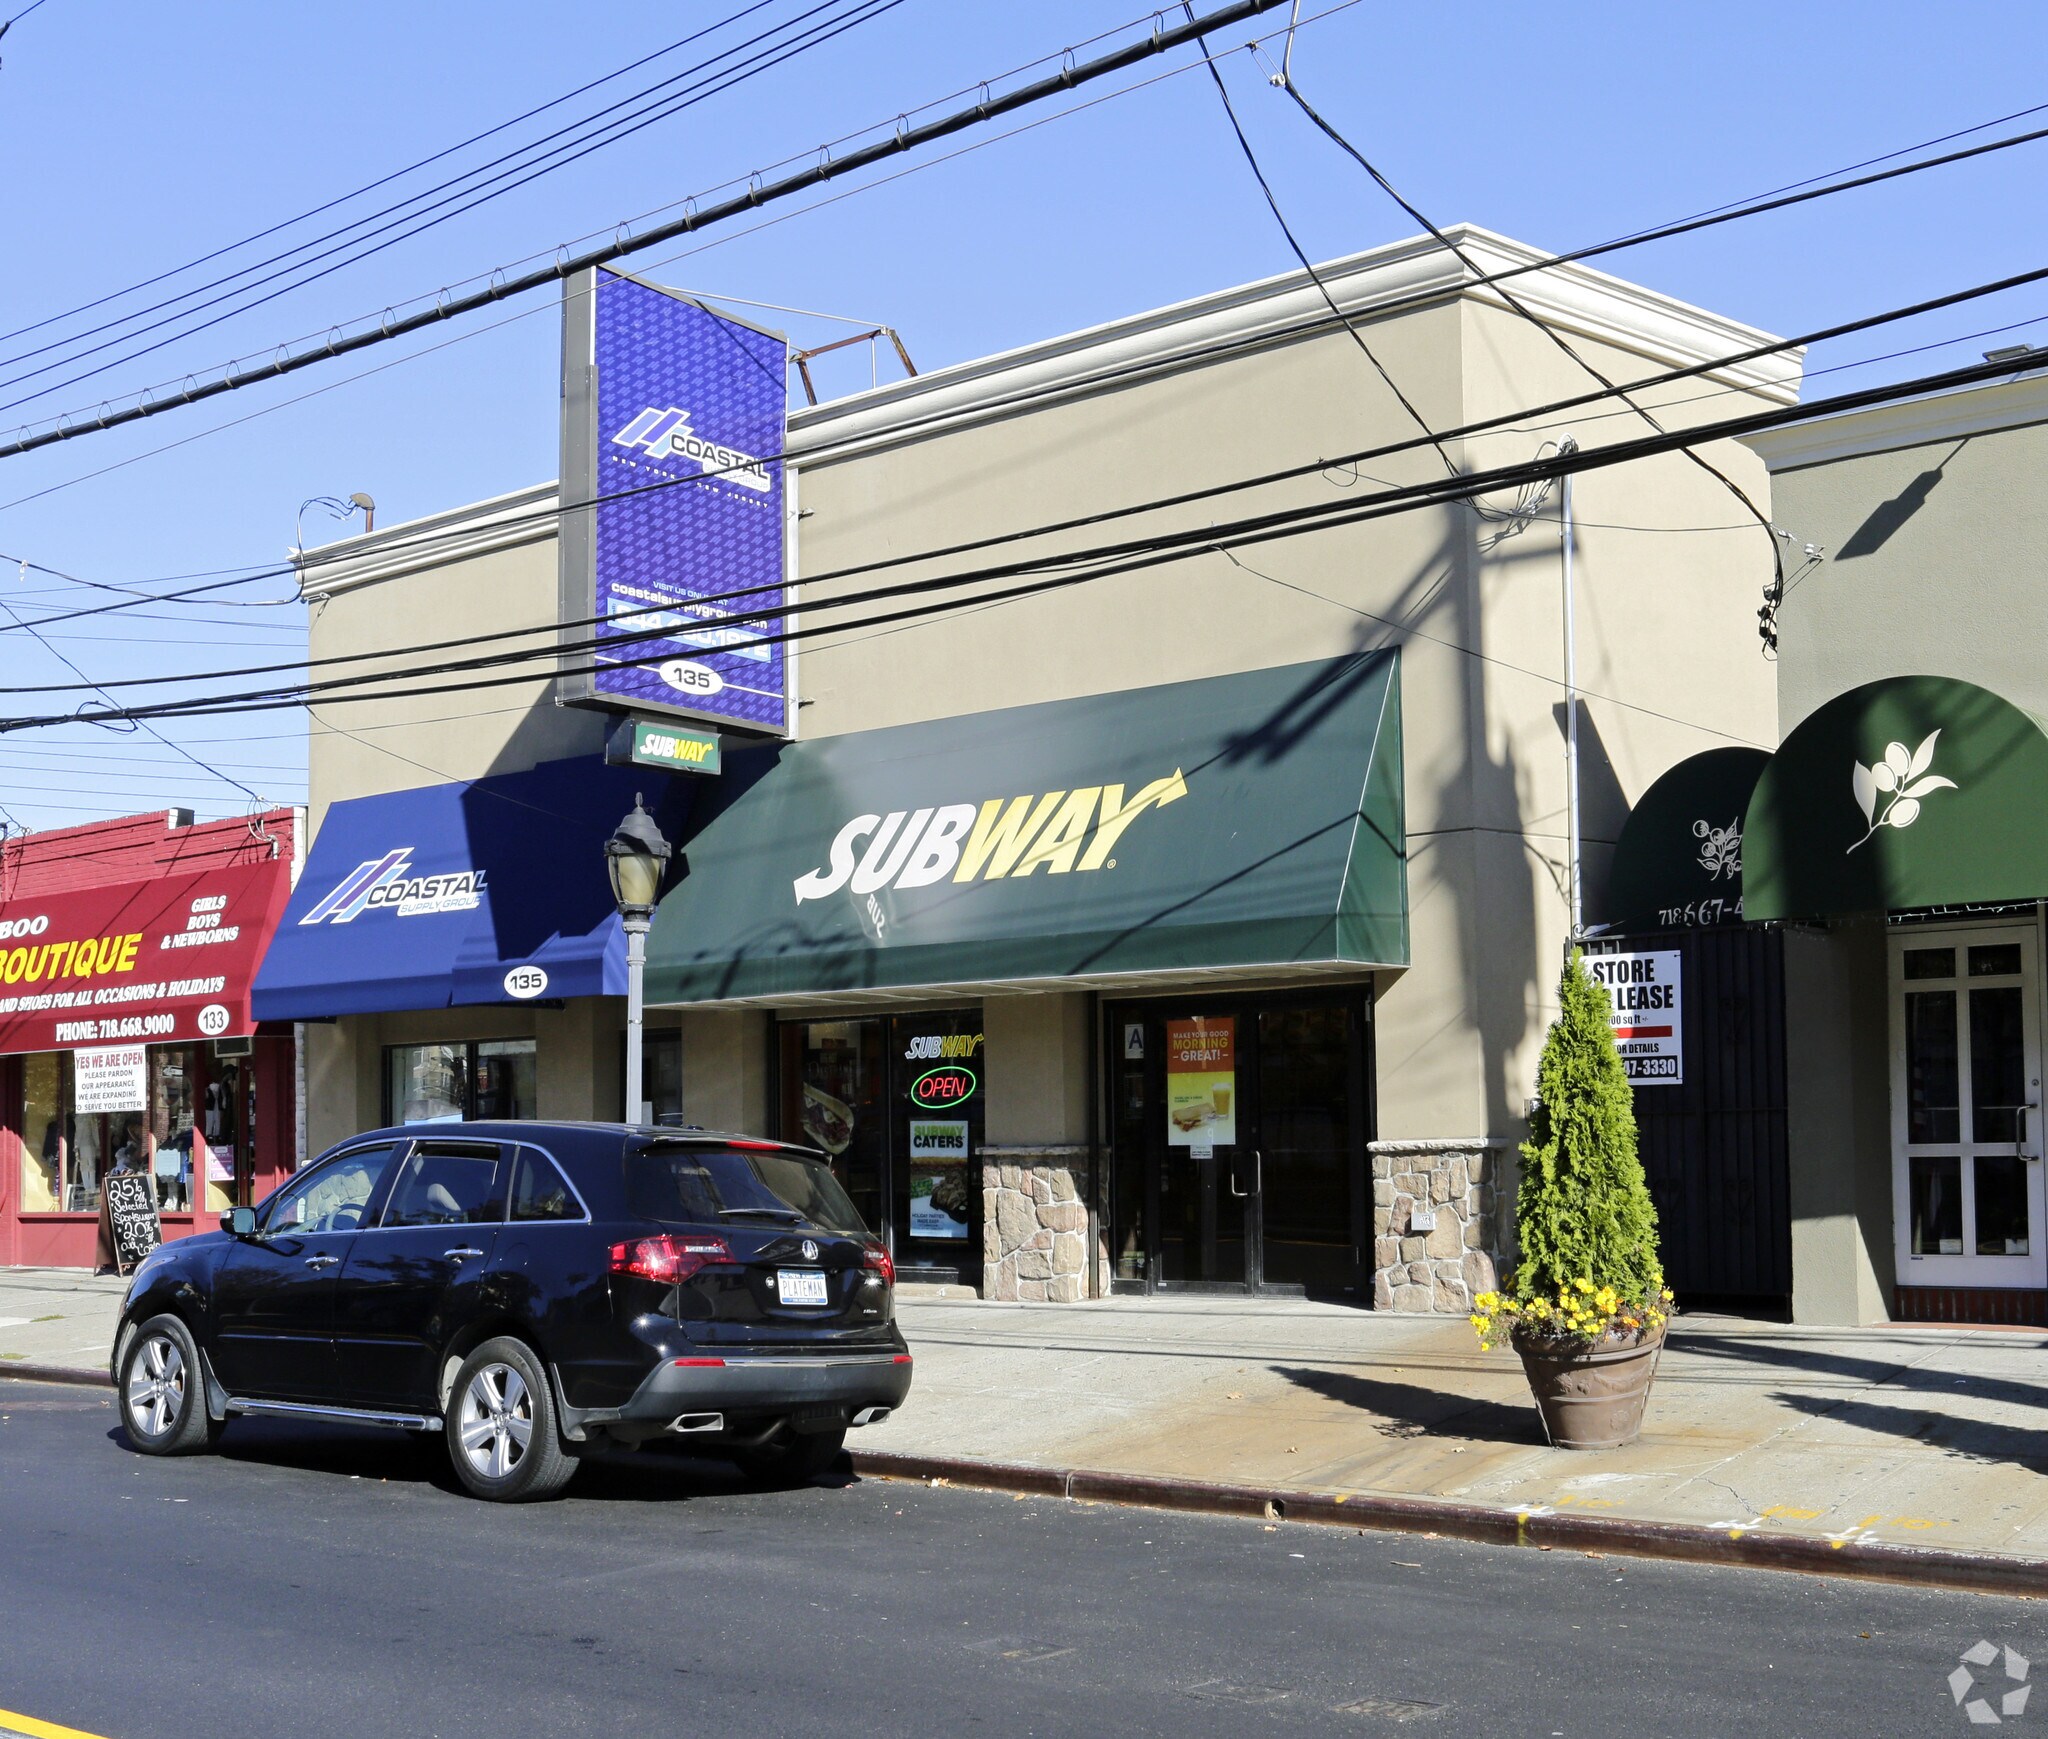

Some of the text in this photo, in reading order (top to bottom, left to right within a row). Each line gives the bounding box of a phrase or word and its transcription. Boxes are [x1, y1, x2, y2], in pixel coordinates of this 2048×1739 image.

[671, 434, 768, 479] COASTAL
[612, 456, 675, 480] NEW YORK
[727, 492, 768, 508] JERSEY
[653, 581, 673, 593] VISIT
[674, 587, 686, 596] US
[673, 668, 710, 688] 135
[640, 733, 714, 762] SUBWAY
[793, 767, 1188, 906] SUBWAY
[367, 869, 487, 904] COASTAL
[191, 895, 227, 913] GIRLS
[400, 897, 480, 913] SUPPLY GROUP
[186, 913, 221, 930] BOYS
[160, 926, 240, 949] & NEWBORNS
[1593, 958, 1655, 984] STORE
[510, 973, 542, 989] 135
[18, 994, 53, 1011] SHOES
[51, 992, 75, 1008] FOR
[72, 990, 93, 1007] ALL
[94, 983, 157, 1005] OCCASIONS
[156, 982, 167, 998] &
[167, 976, 226, 998] HOLIDAYS
[1617, 985, 1674, 1010] LEASE
[55, 1013, 175, 1042] PHONE: 718.668.9000
[204, 1011, 224, 1030] 133
[1622, 1016, 1633, 1025] sq
[1634, 1014, 1641, 1024] ft
[904, 1032, 985, 1060] SUBWAY
[1129, 1028, 1143, 1049] A
[1173, 1037, 1229, 1050] MORNING
[1180, 1049, 1220, 1061] GREAT!
[1629, 1043, 1659, 1054] DETAILS
[76, 1052, 143, 1069] YES WE ARE OPEN
[84, 1069, 133, 1079] PLEASE PARDON
[95, 1080, 135, 1089] APPEARANCE
[919, 1077, 966, 1098] OPEN
[78, 1090, 137, 1101] WE ARE EXPANDING
[84, 1103, 102, 1111] SERVE
[103, 1102, 117, 1110] YOU
[118, 1100, 142, 1108] BETTER
[914, 1125, 964, 1136] SUBWAY
[913, 1135, 964, 1149] CATERS
[110, 1178, 142, 1201] 25%
[114, 1198, 148, 1213] Selected
[114, 1211, 156, 1225] Sportswear
[123, 1221, 154, 1240] 20%
[782, 1280, 823, 1297] PLATEMAN
